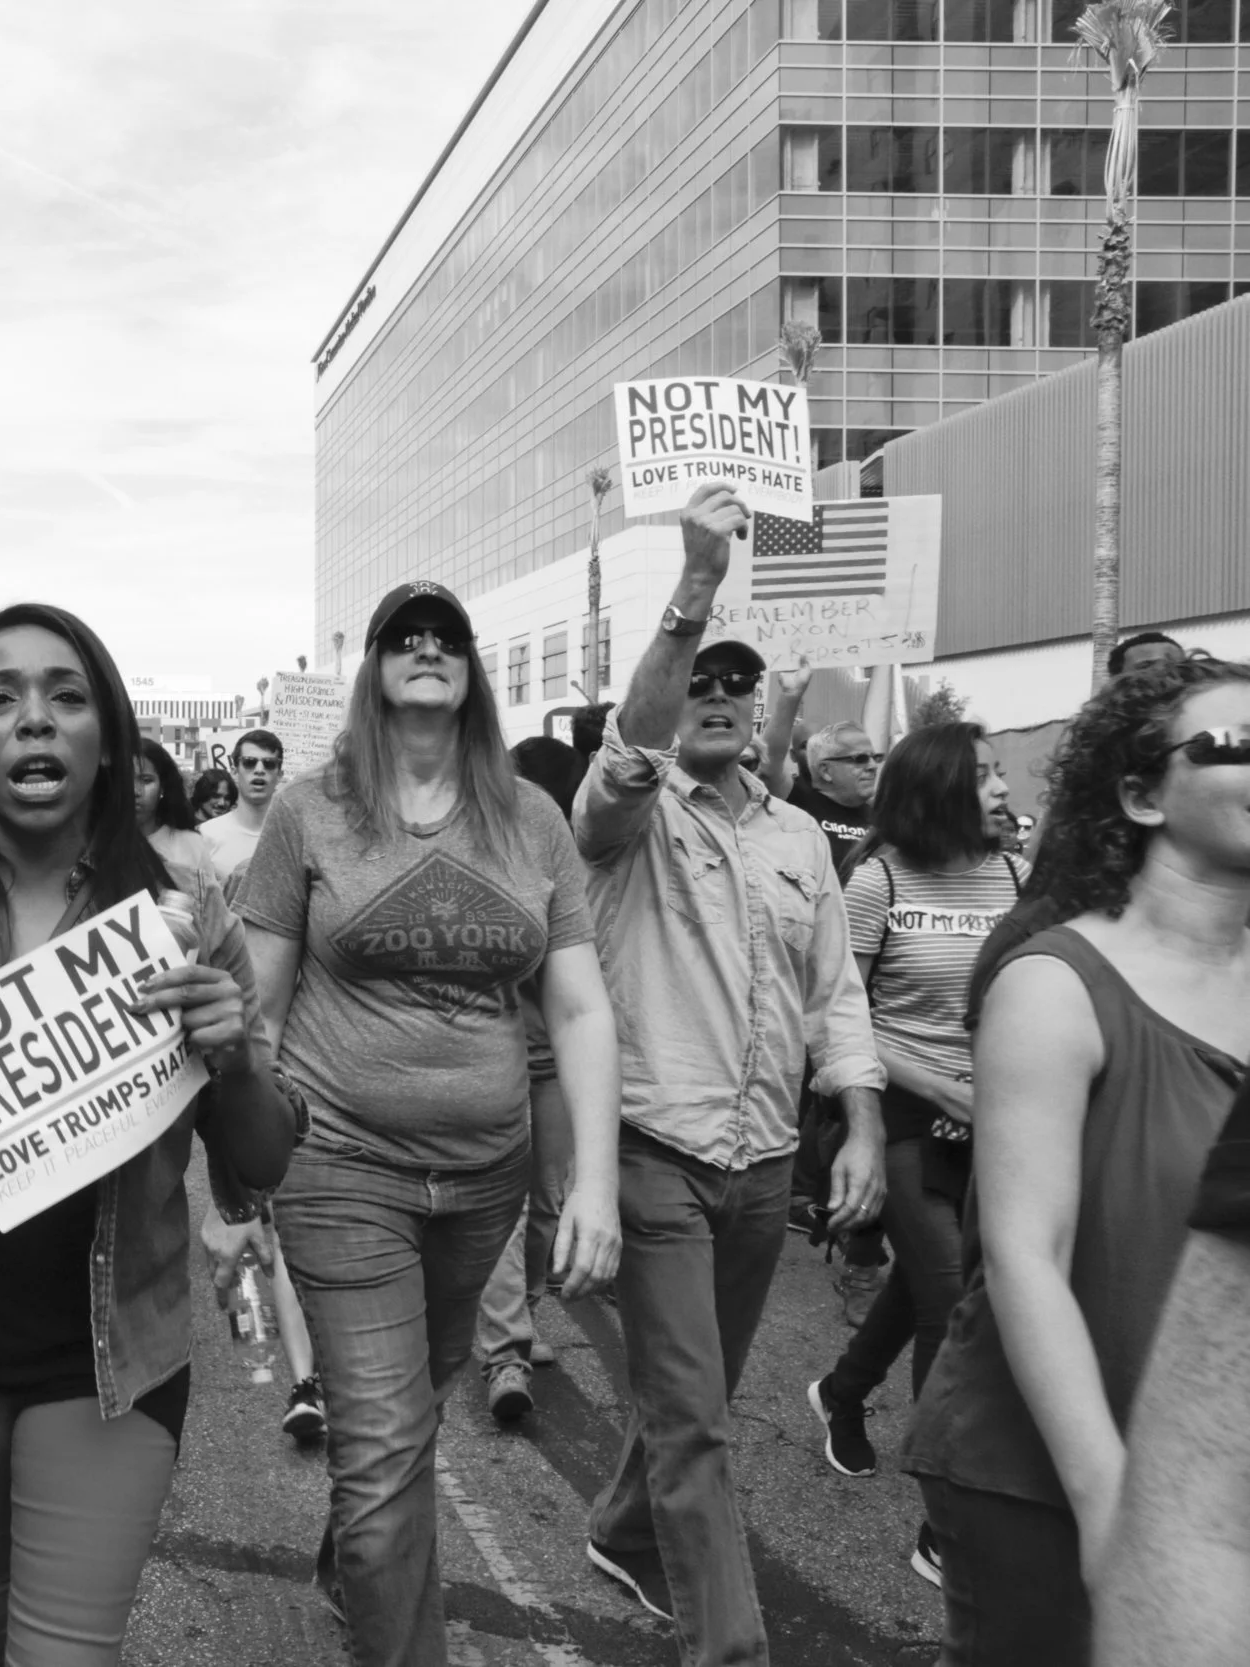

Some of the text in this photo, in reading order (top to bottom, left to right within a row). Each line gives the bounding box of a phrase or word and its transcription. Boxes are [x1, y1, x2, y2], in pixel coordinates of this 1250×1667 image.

[627, 381, 797, 421] NOT MY
[628, 413, 801, 464] PRESIDENT!
[631, 464, 679, 488] LOVE
[683, 461, 757, 483] TRUMPS
[761, 470, 804, 493] HATE
[708, 597, 876, 628] REMEMBER
[889, 911, 928, 930] NOT
[932, 914, 954, 932] MY
[55, 905, 150, 995] MY
[362, 928, 434, 956] ZOO
[438, 924, 528, 953] YORK
[48, 1076, 152, 1145] TRUMPS
